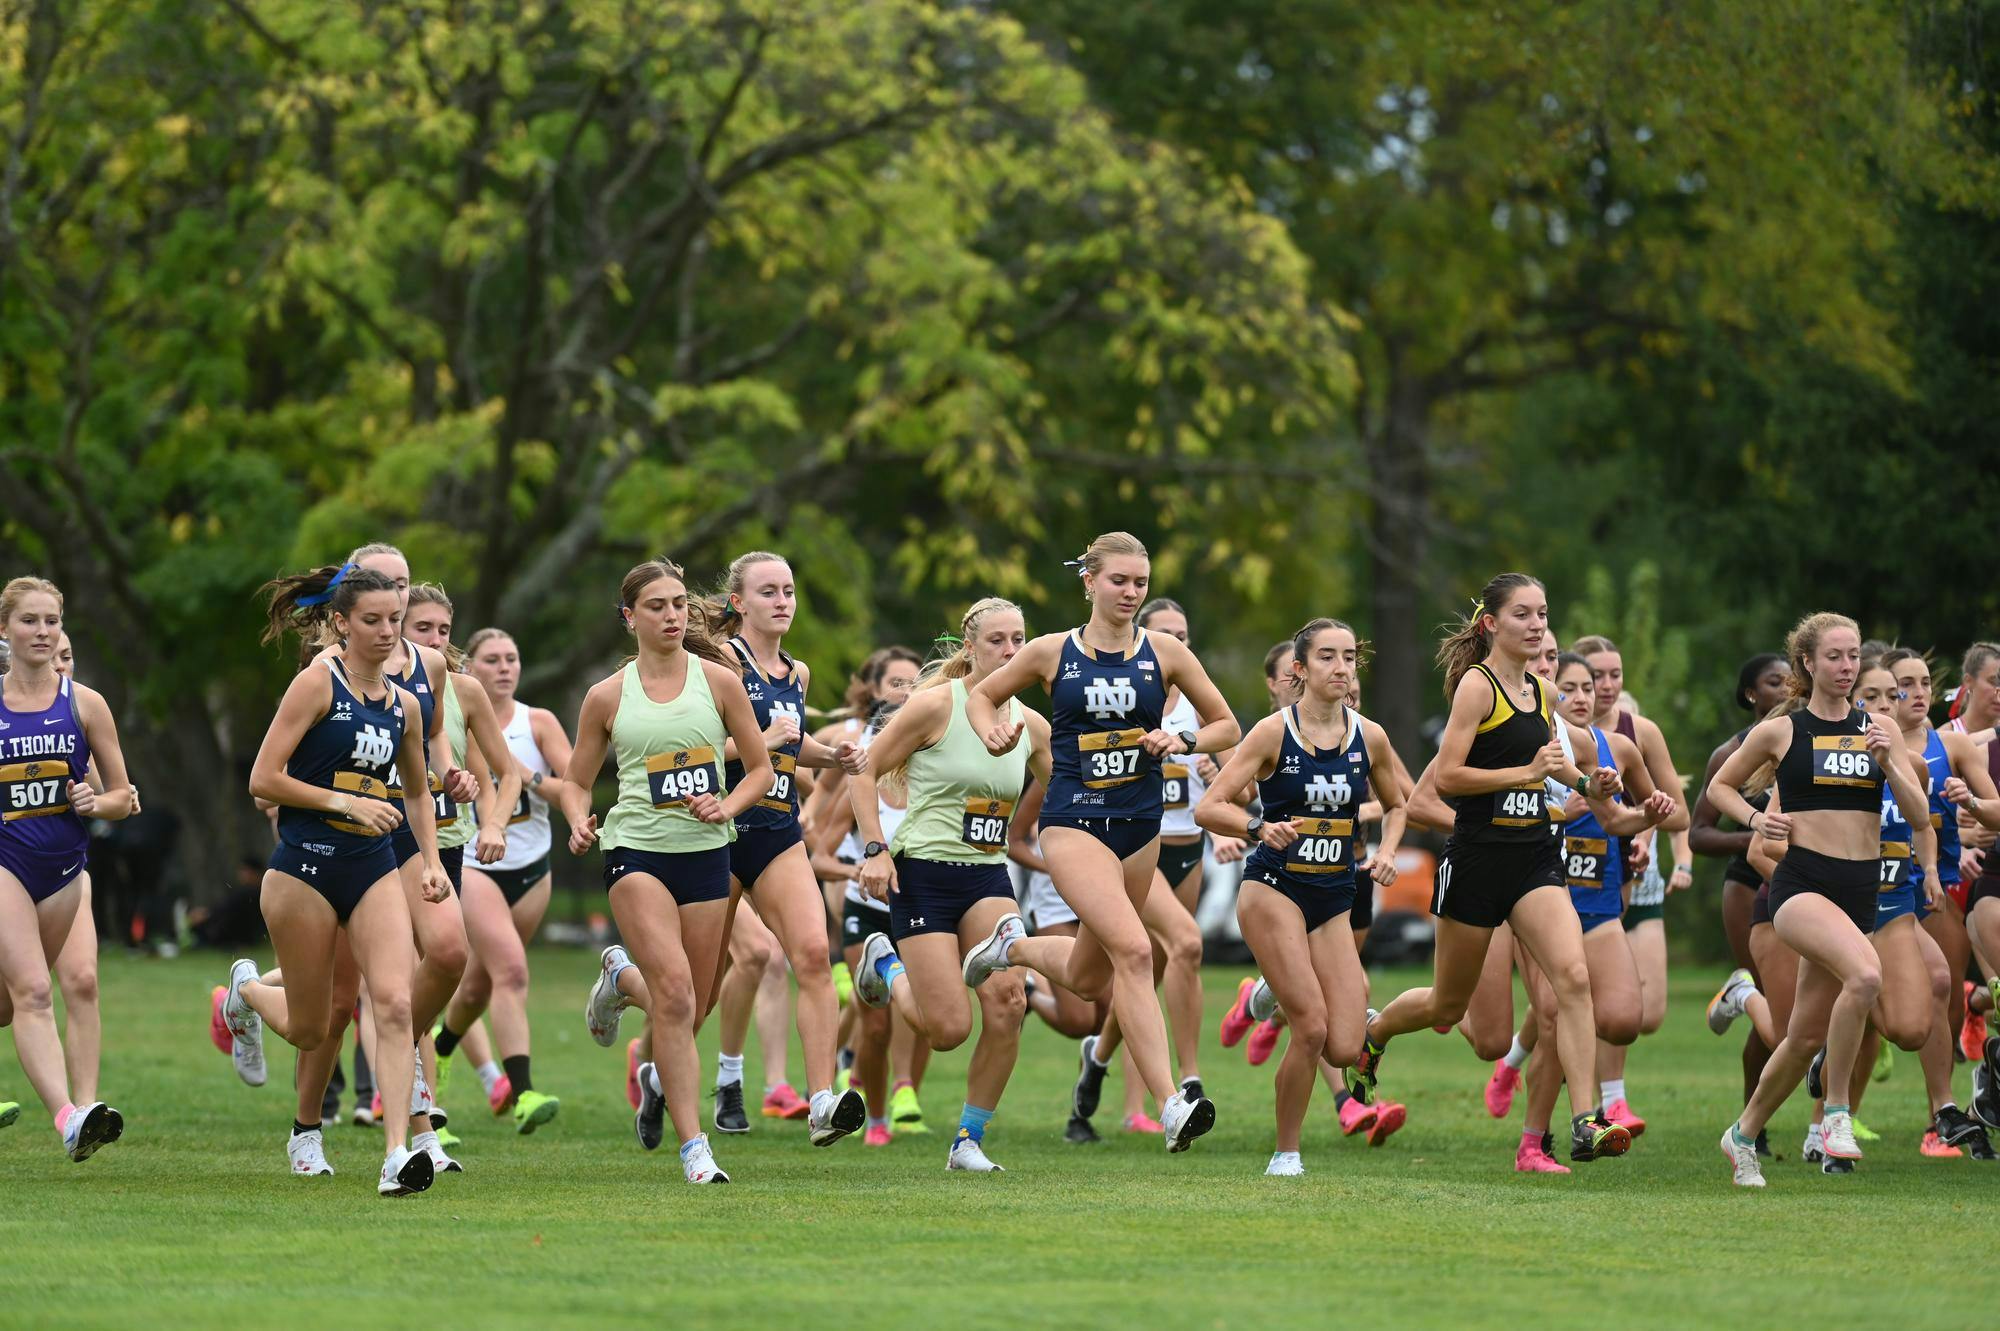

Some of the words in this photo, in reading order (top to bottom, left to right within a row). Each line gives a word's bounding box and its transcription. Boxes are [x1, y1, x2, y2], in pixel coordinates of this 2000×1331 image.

[1091, 750, 1139, 778] 397
[1823, 752, 1870, 777] 496
[11, 779, 59, 808] 507
[662, 767, 710, 798] 499
[1502, 792, 1539, 816] 494
[970, 817, 1003, 842] 502
[1298, 838, 1342, 863] 400
